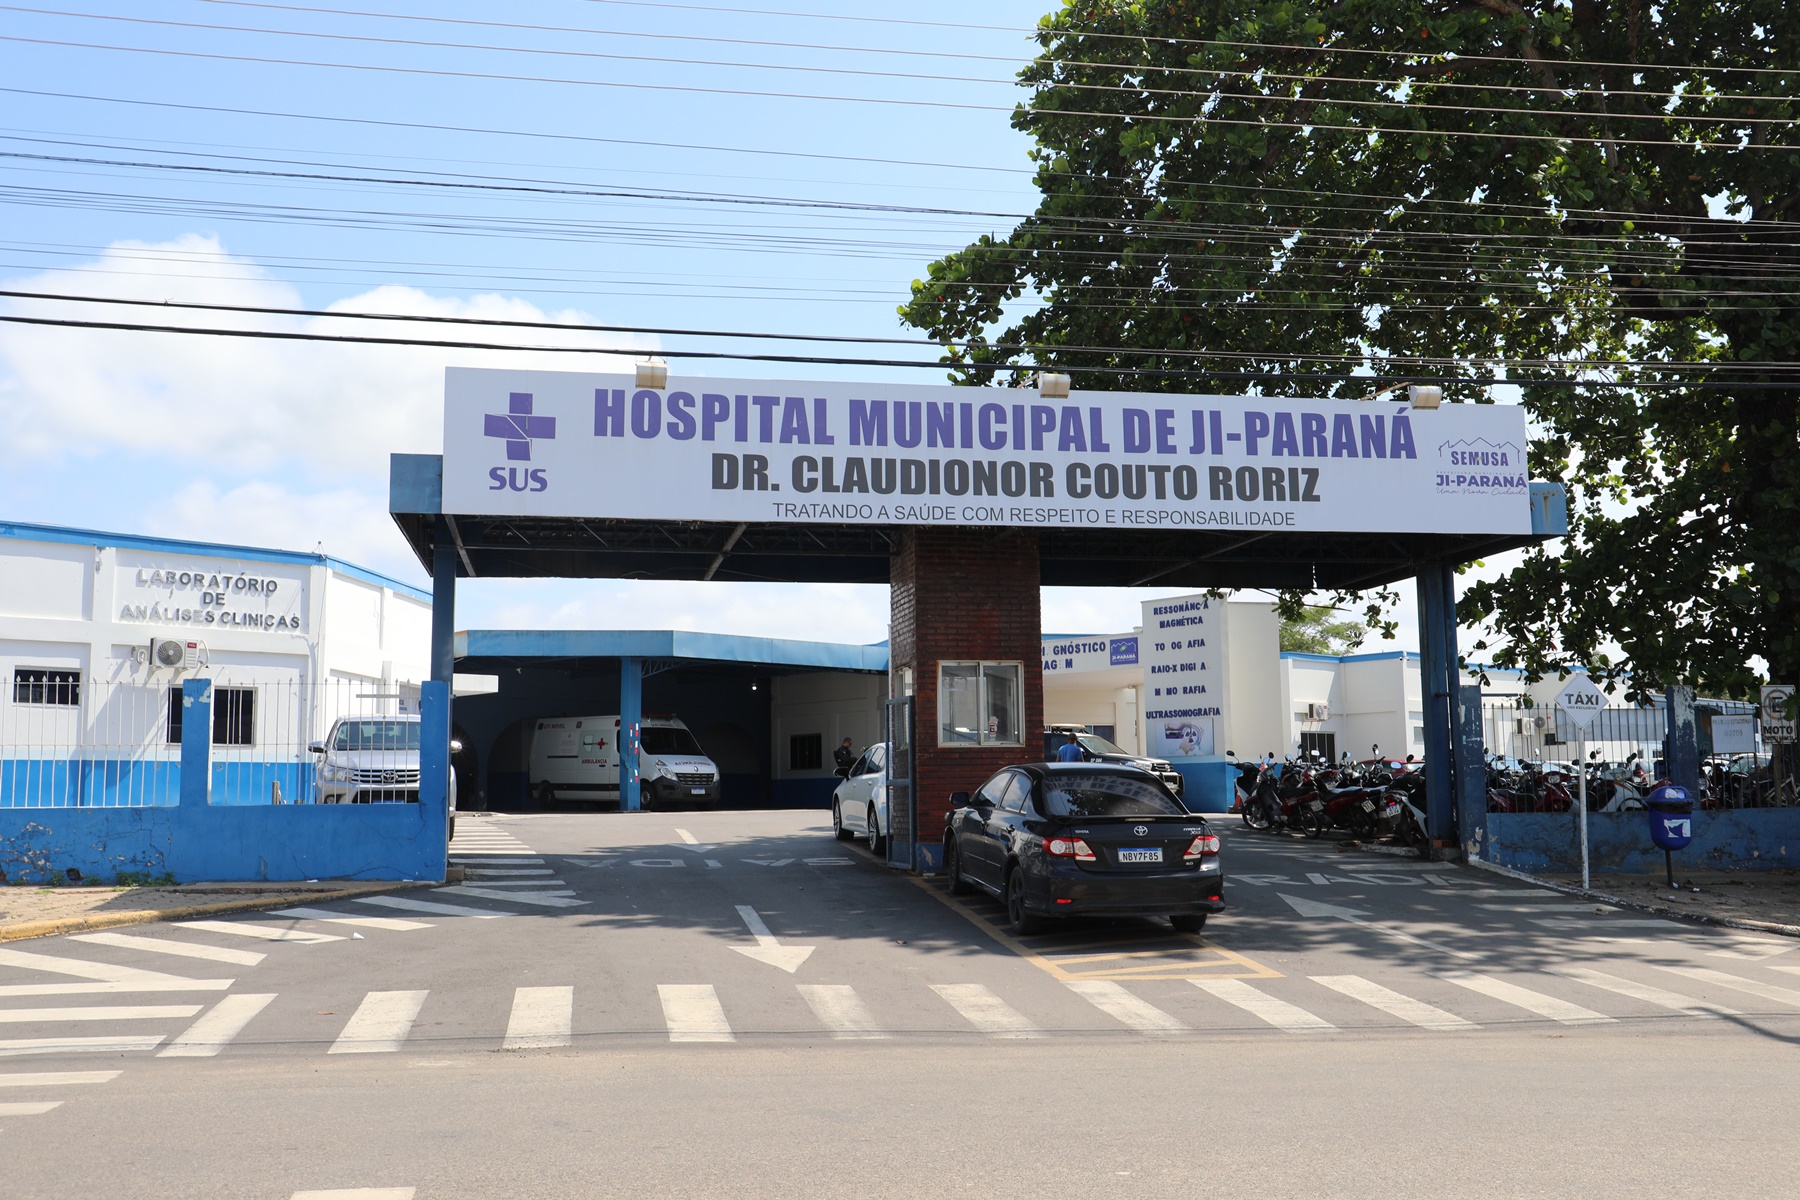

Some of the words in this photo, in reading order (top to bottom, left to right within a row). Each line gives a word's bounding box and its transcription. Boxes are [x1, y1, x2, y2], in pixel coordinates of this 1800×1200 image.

[593, 388, 835, 445] HOSPITAL
[848, 399, 1110, 452] MUNICIPAL
[1122, 408, 1177, 455] DE
[1189, 406, 1418, 459] JI-PARANÁ
[1451, 451, 1509, 467] SEMUSA
[489, 466, 548, 492] SUS
[711, 452, 780, 491] DR.
[791, 455, 1055, 498] CLAUDIONOR
[1065, 462, 1198, 500] COUTO
[1208, 465, 1321, 502] RORIZ
[1436, 473, 1527, 488] JI-PARANÁ
[772, 502, 873, 519] TRATANDO
[877, 505, 890, 520] A
[894, 502, 956, 521] SAÚDE
[962, 506, 1005, 522] COM
[1010, 508, 1100, 523] RESPEITO
[1105, 510, 1116, 524] E
[1122, 510, 1296, 526] RESPONSABILIDADE
[138, 569, 278, 592] LABORATÓRIO
[203, 592, 226, 606] DE
[120, 600, 215, 623] ANÁLISES
[1153, 601, 1209, 616] RESSONÂNCA
[1159, 616, 1203, 629] MAGNÉTICA
[1041, 641, 1107, 657] IGNÓSTICO
[1155, 638, 1206, 652] TOOGAFIA
[1151, 664, 1178, 674] RAIO-X
[1180, 661, 1207, 672] DIGIA
[1154, 685, 1206, 697] MMORAFIA
[1565, 692, 1599, 706] TÁXI
[1146, 707, 1221, 720] ULTRASSONOGRAFIA
[1763, 726, 1794, 735] MOTO
[1122, 852, 1159, 862] NBY7F85
